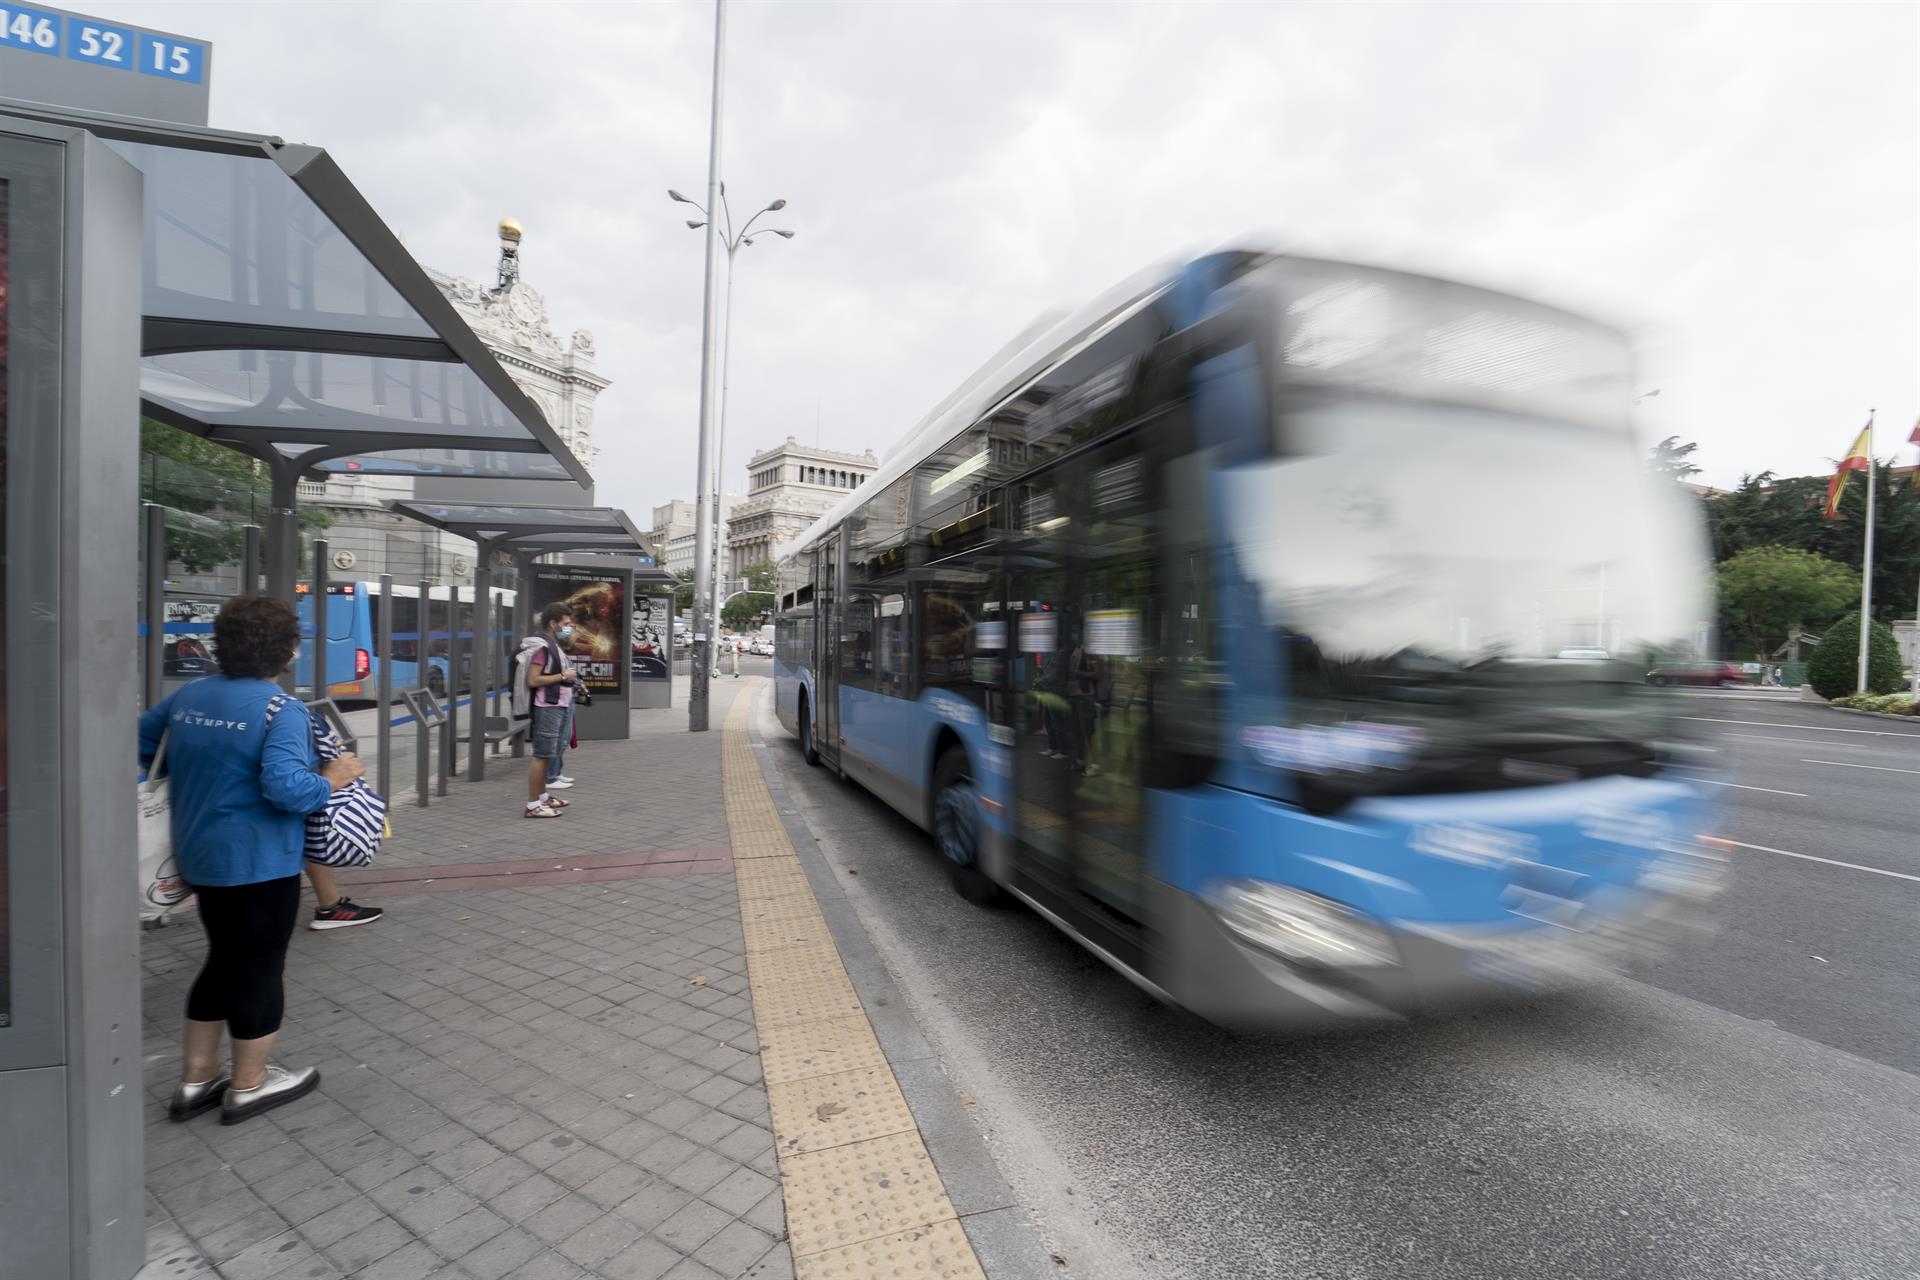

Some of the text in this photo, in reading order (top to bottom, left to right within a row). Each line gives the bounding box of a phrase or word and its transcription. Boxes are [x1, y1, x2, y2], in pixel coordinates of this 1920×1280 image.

[0, 9, 56, 48] 146
[79, 27, 124, 62] 52
[152, 41, 190, 75] 15
